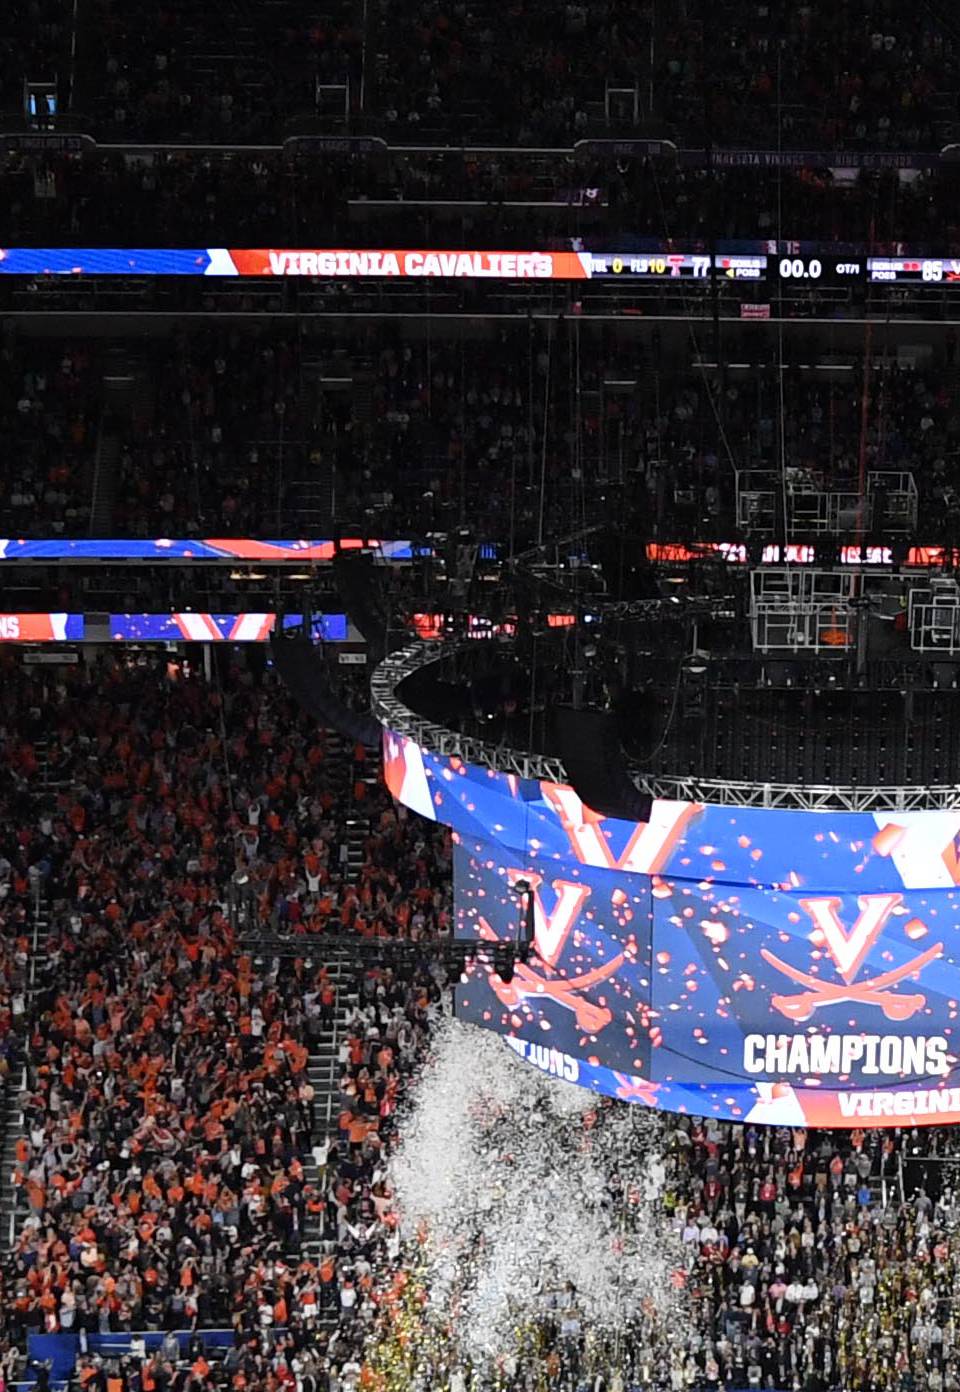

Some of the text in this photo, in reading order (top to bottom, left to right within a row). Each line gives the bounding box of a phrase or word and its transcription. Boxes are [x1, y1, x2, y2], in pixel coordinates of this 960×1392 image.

[270, 252, 553, 278] VIRGINIA CAVALIERS
[613, 257, 623, 273] 0
[649, 258, 666, 273] 10
[691, 256, 712, 277] 77
[779, 258, 822, 278] 00.0
[921, 260, 943, 281] 85
[743, 1033, 951, 1076] CHAMPIONS
